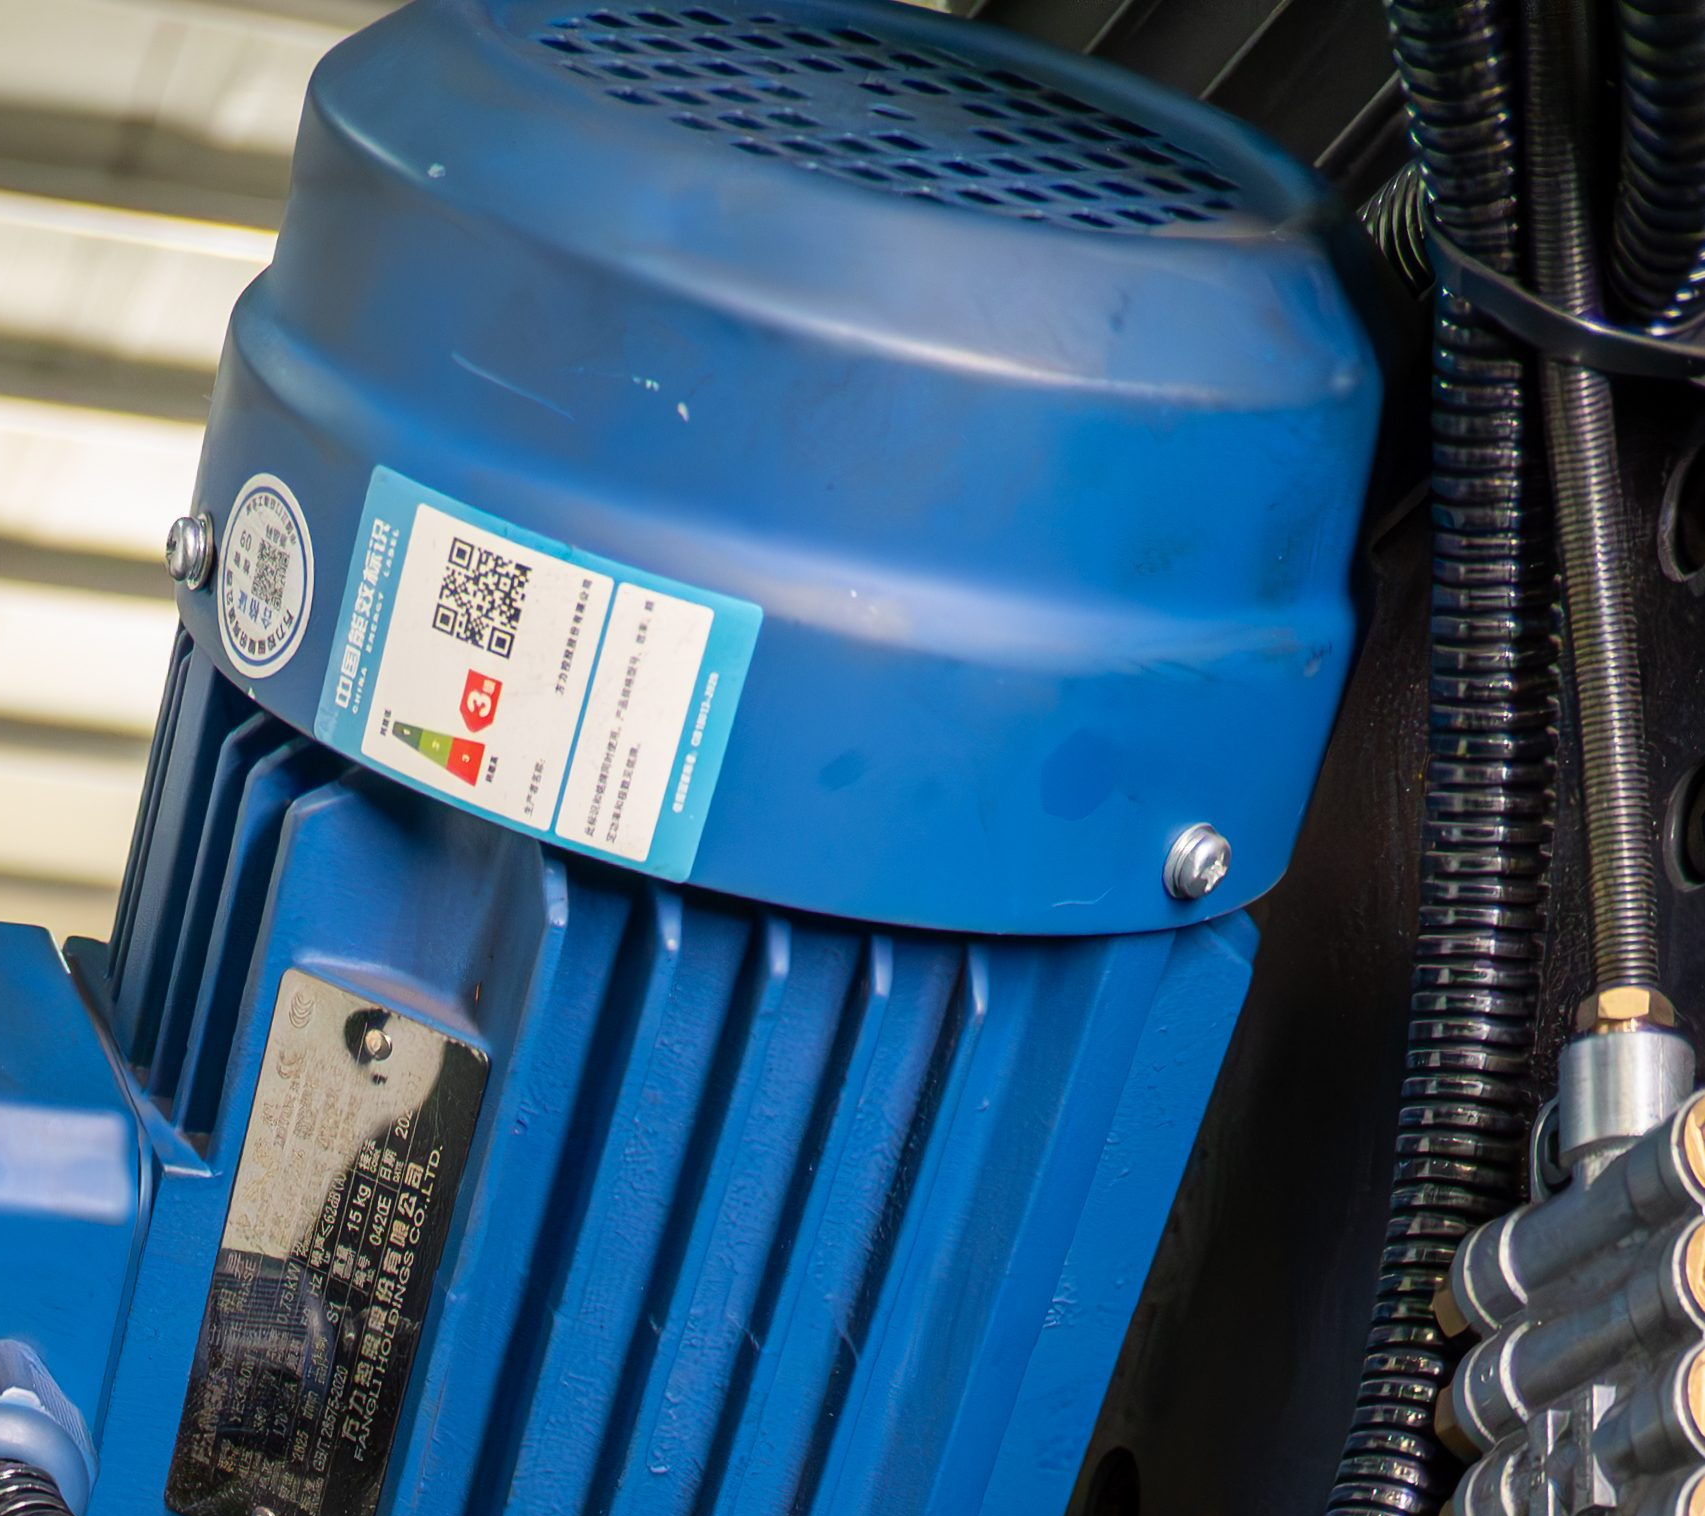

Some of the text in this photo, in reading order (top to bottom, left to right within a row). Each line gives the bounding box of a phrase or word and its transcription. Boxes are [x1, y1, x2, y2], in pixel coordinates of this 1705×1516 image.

[335, 517, 390, 710] 中国能效标识
[351, 526, 401, 715] CHINA ENERGY LABEL
[345, 1180, 372, 1235] 15 kg
[368, 1193, 393, 1248] 0420E
[379, 1146, 398, 1182] 日期
[353, 1377, 383, 1463] FANGLI
[375, 1248, 416, 1373] HOLDINGS
